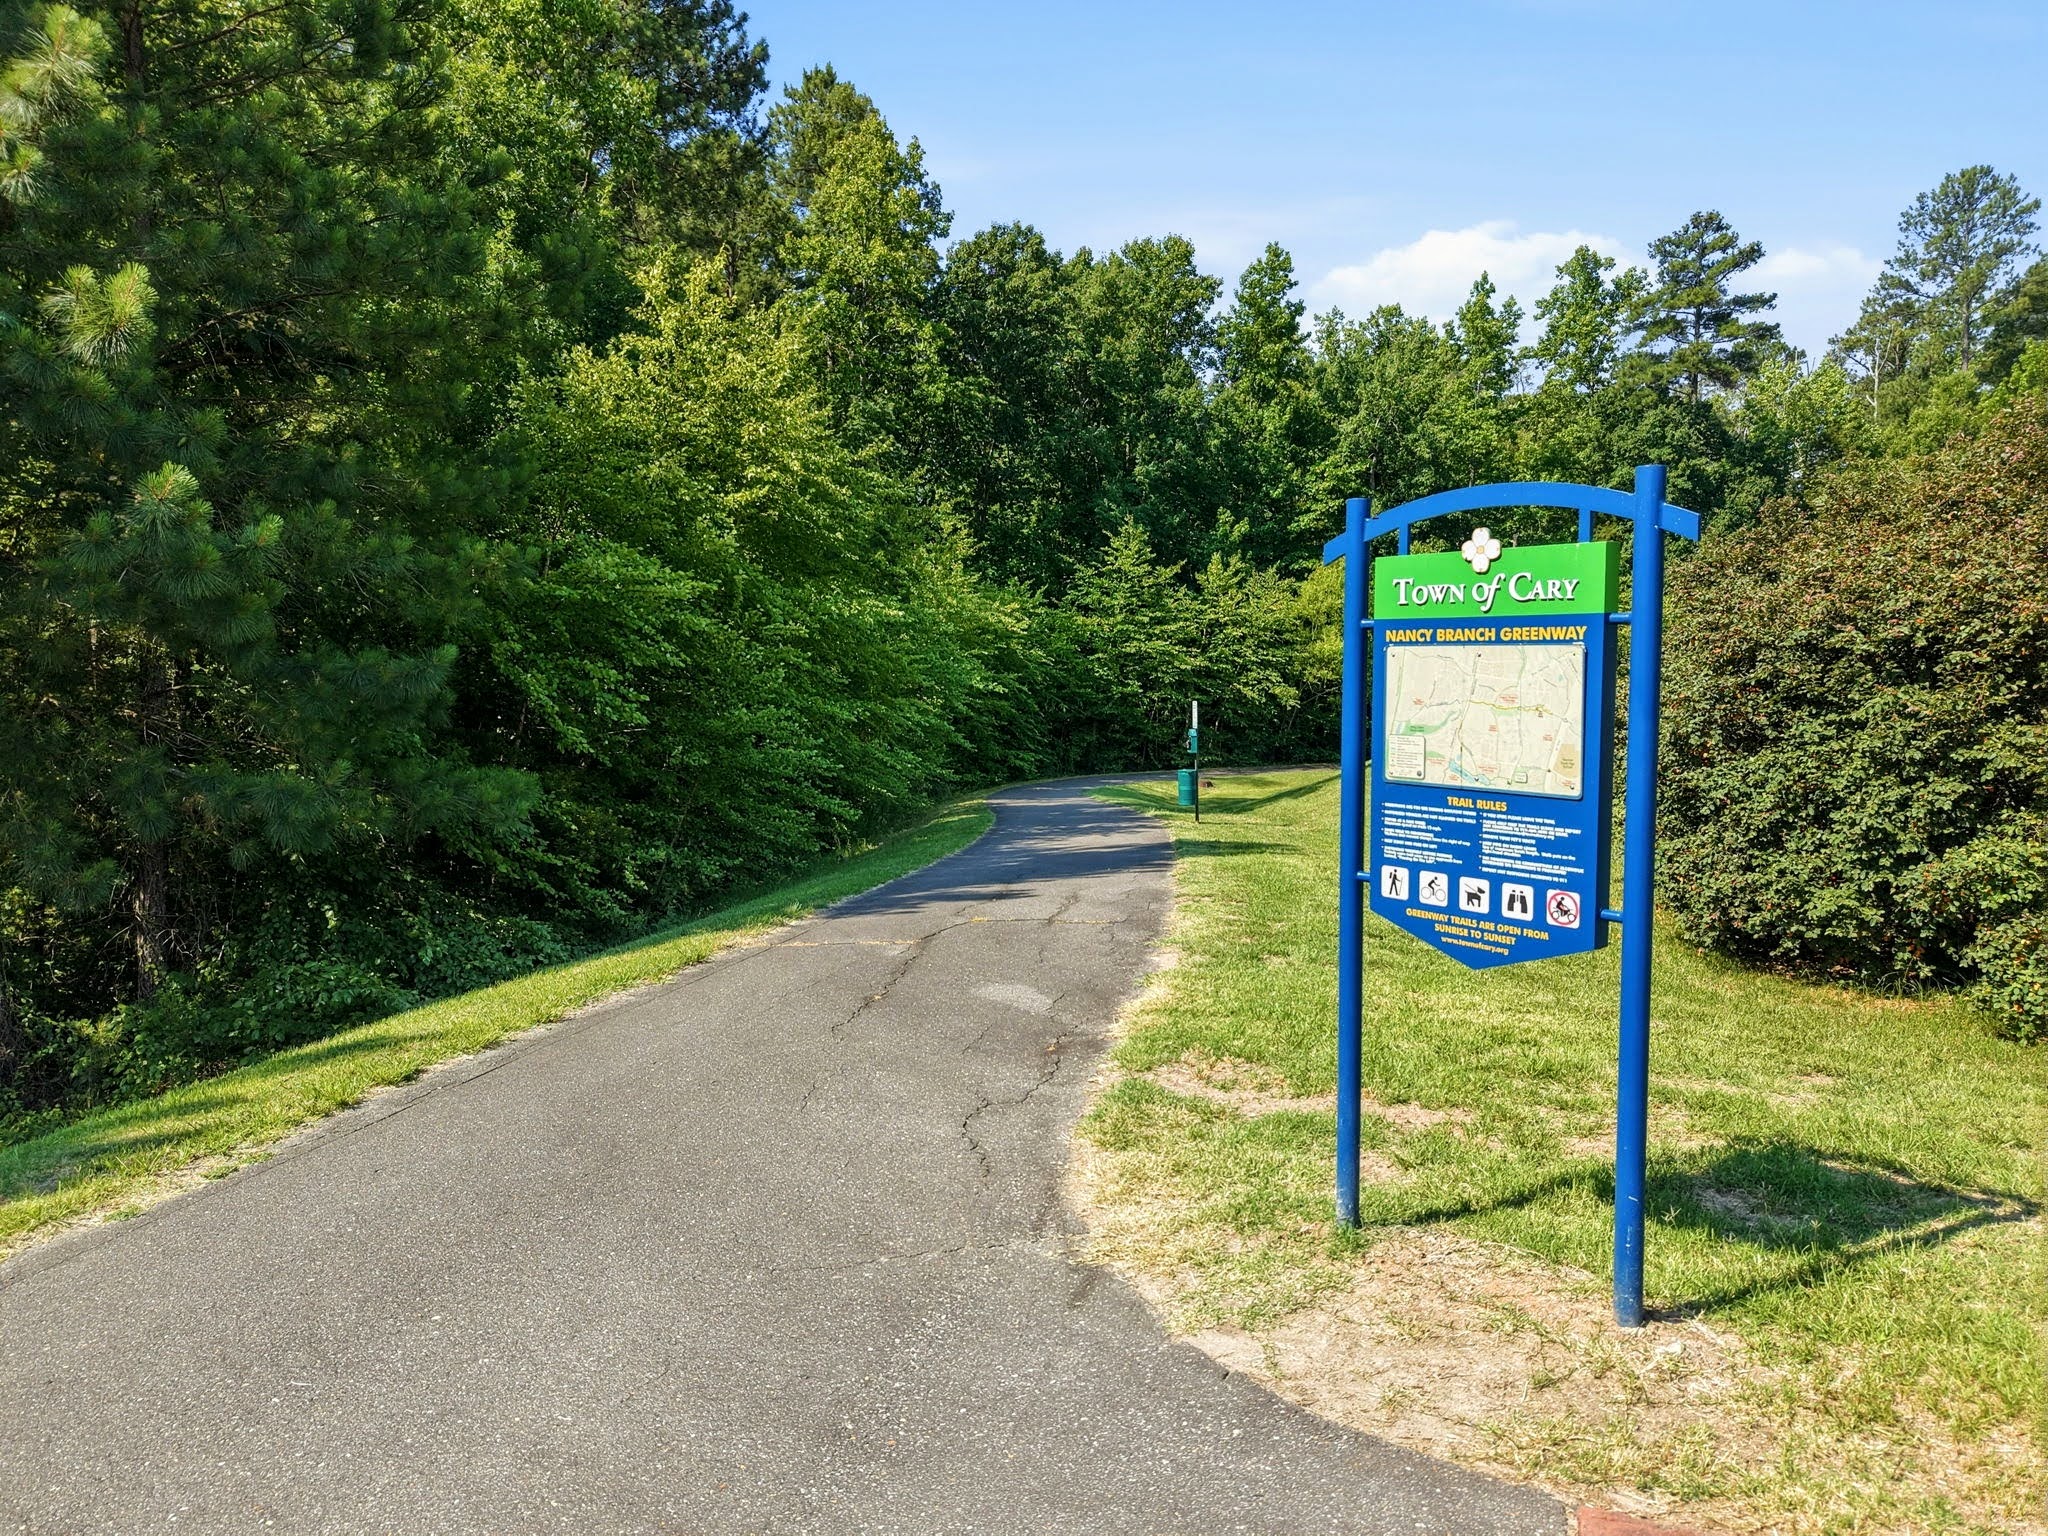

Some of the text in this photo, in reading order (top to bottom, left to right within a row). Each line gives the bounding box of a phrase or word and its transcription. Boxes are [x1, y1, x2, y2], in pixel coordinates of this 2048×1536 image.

[1471, 573, 1506, 612] of
[1385, 626, 1587, 642] NANCY BRANCH GREENWAY
[1446, 796, 1475, 809] TRAIL
[1476, 799, 1508, 812] RULES
[1405, 908, 1549, 940] GREENWAY TRAILS ARE OPEN FROM
[1434, 923, 1517, 945] SUNRISE TO SUNSET
